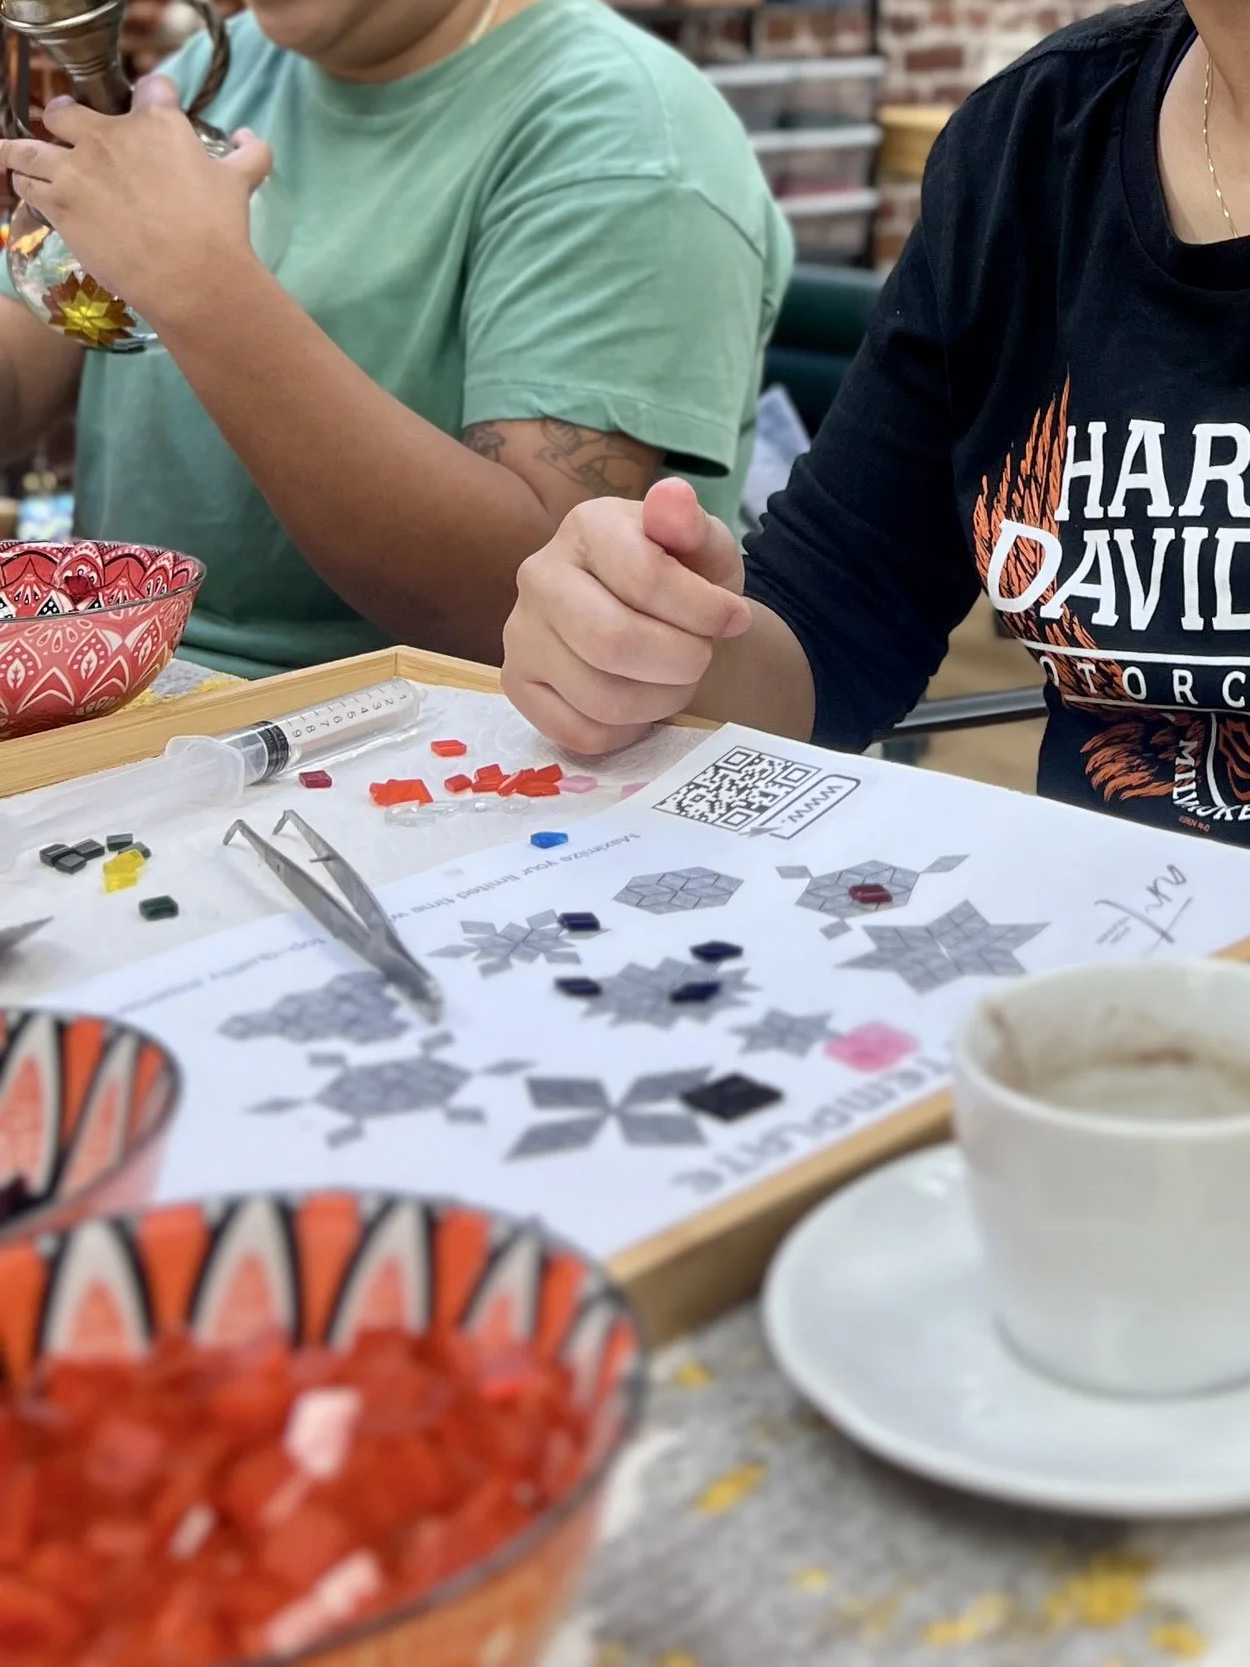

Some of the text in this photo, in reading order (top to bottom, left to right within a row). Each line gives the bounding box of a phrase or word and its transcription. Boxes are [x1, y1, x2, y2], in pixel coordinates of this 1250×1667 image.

[559, 832, 641, 863] Maximize
[521, 859, 559, 877] your
[455, 873, 521, 901] limited
[410, 897, 456, 914] time
